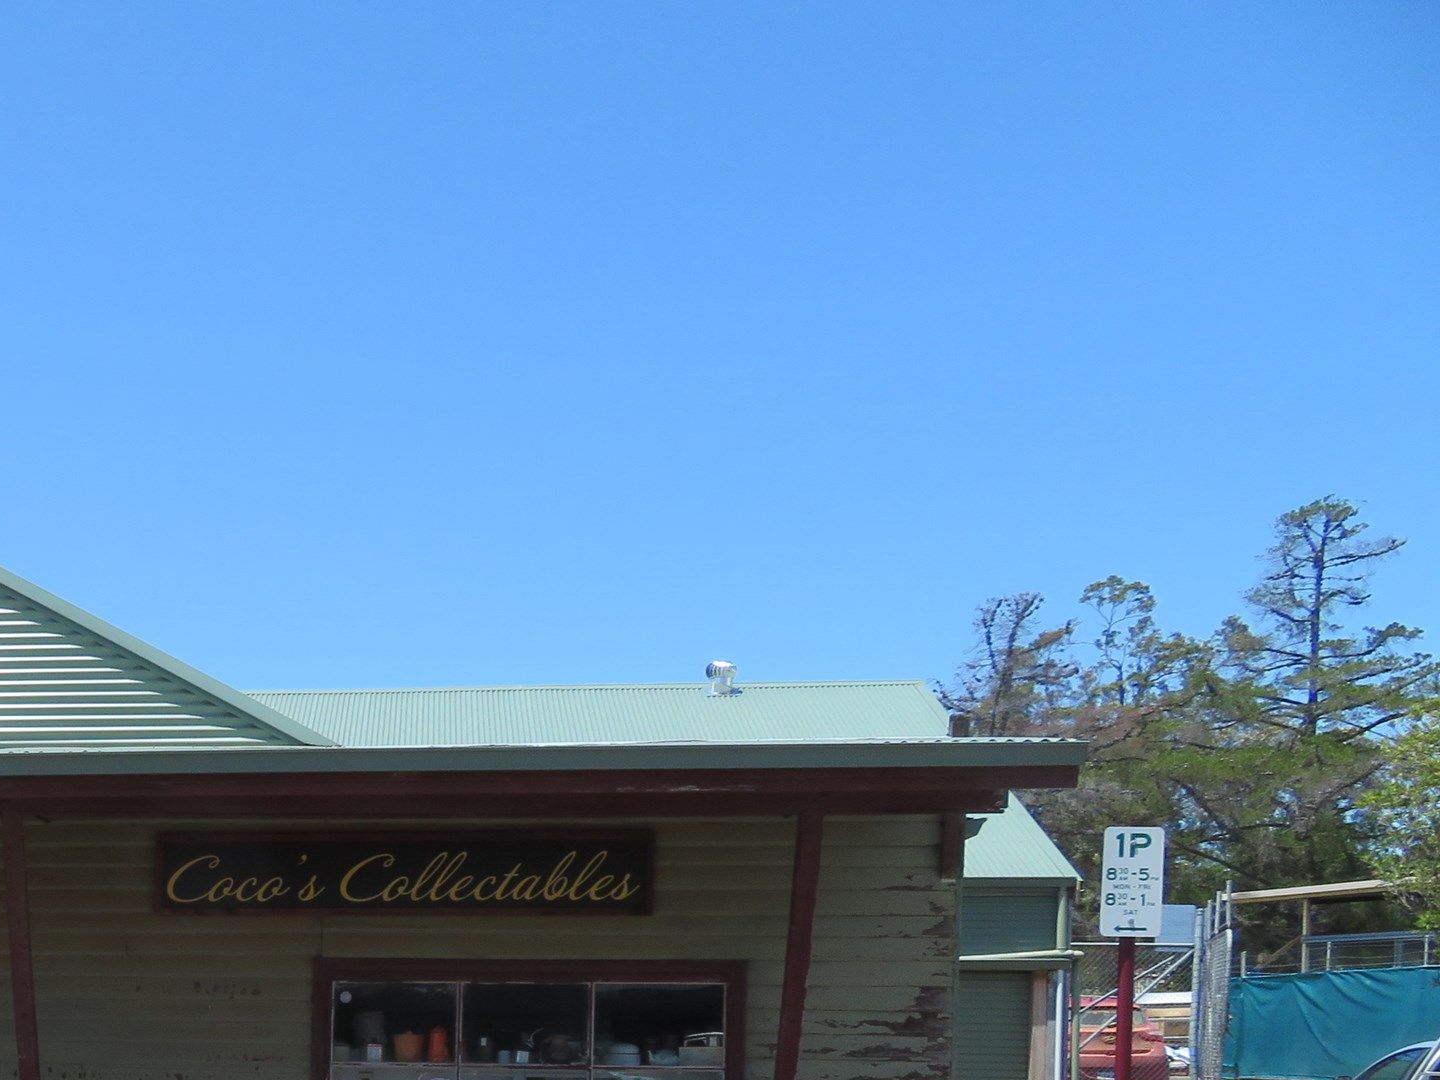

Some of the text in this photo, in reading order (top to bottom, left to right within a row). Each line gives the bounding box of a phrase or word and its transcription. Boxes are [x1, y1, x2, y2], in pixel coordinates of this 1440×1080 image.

[1116, 833, 1152, 858] 1P
[165, 850, 641, 903] Coco's Collectables
